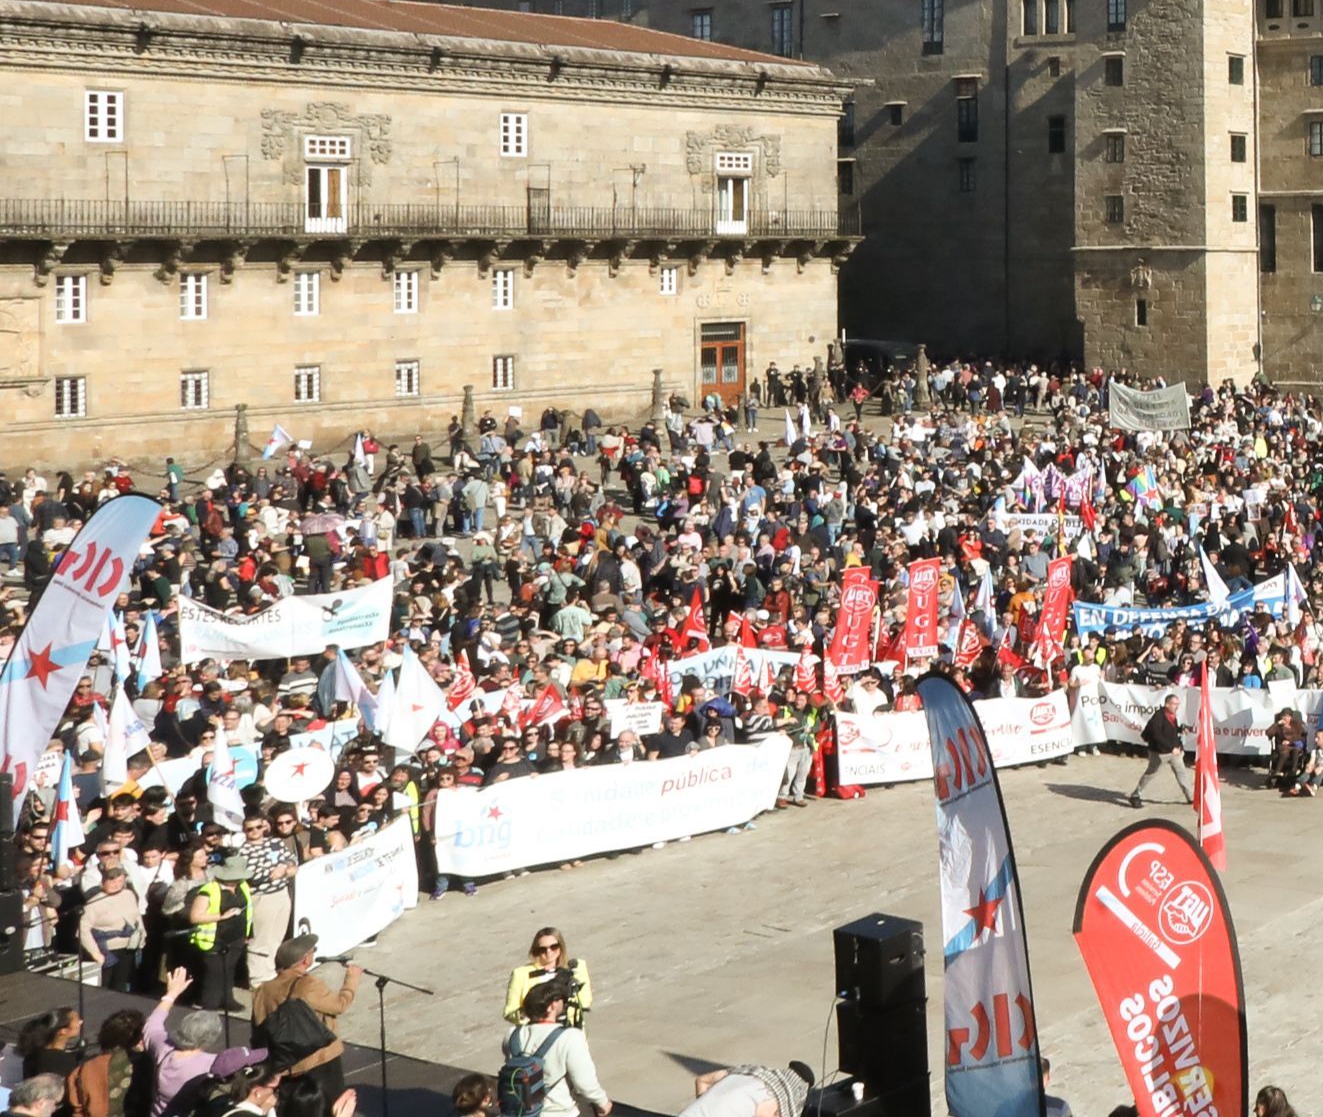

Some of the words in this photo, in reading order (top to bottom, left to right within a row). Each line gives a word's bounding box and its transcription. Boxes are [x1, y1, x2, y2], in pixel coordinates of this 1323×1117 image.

[914, 570, 935, 583] UGT
[847, 588, 871, 601] UGT
[181, 607, 217, 624] ESTES
[913, 595, 930, 646] UGT
[1079, 608, 1106, 626] EN
[659, 762, 733, 796] pública
[454, 819, 512, 849] bng
